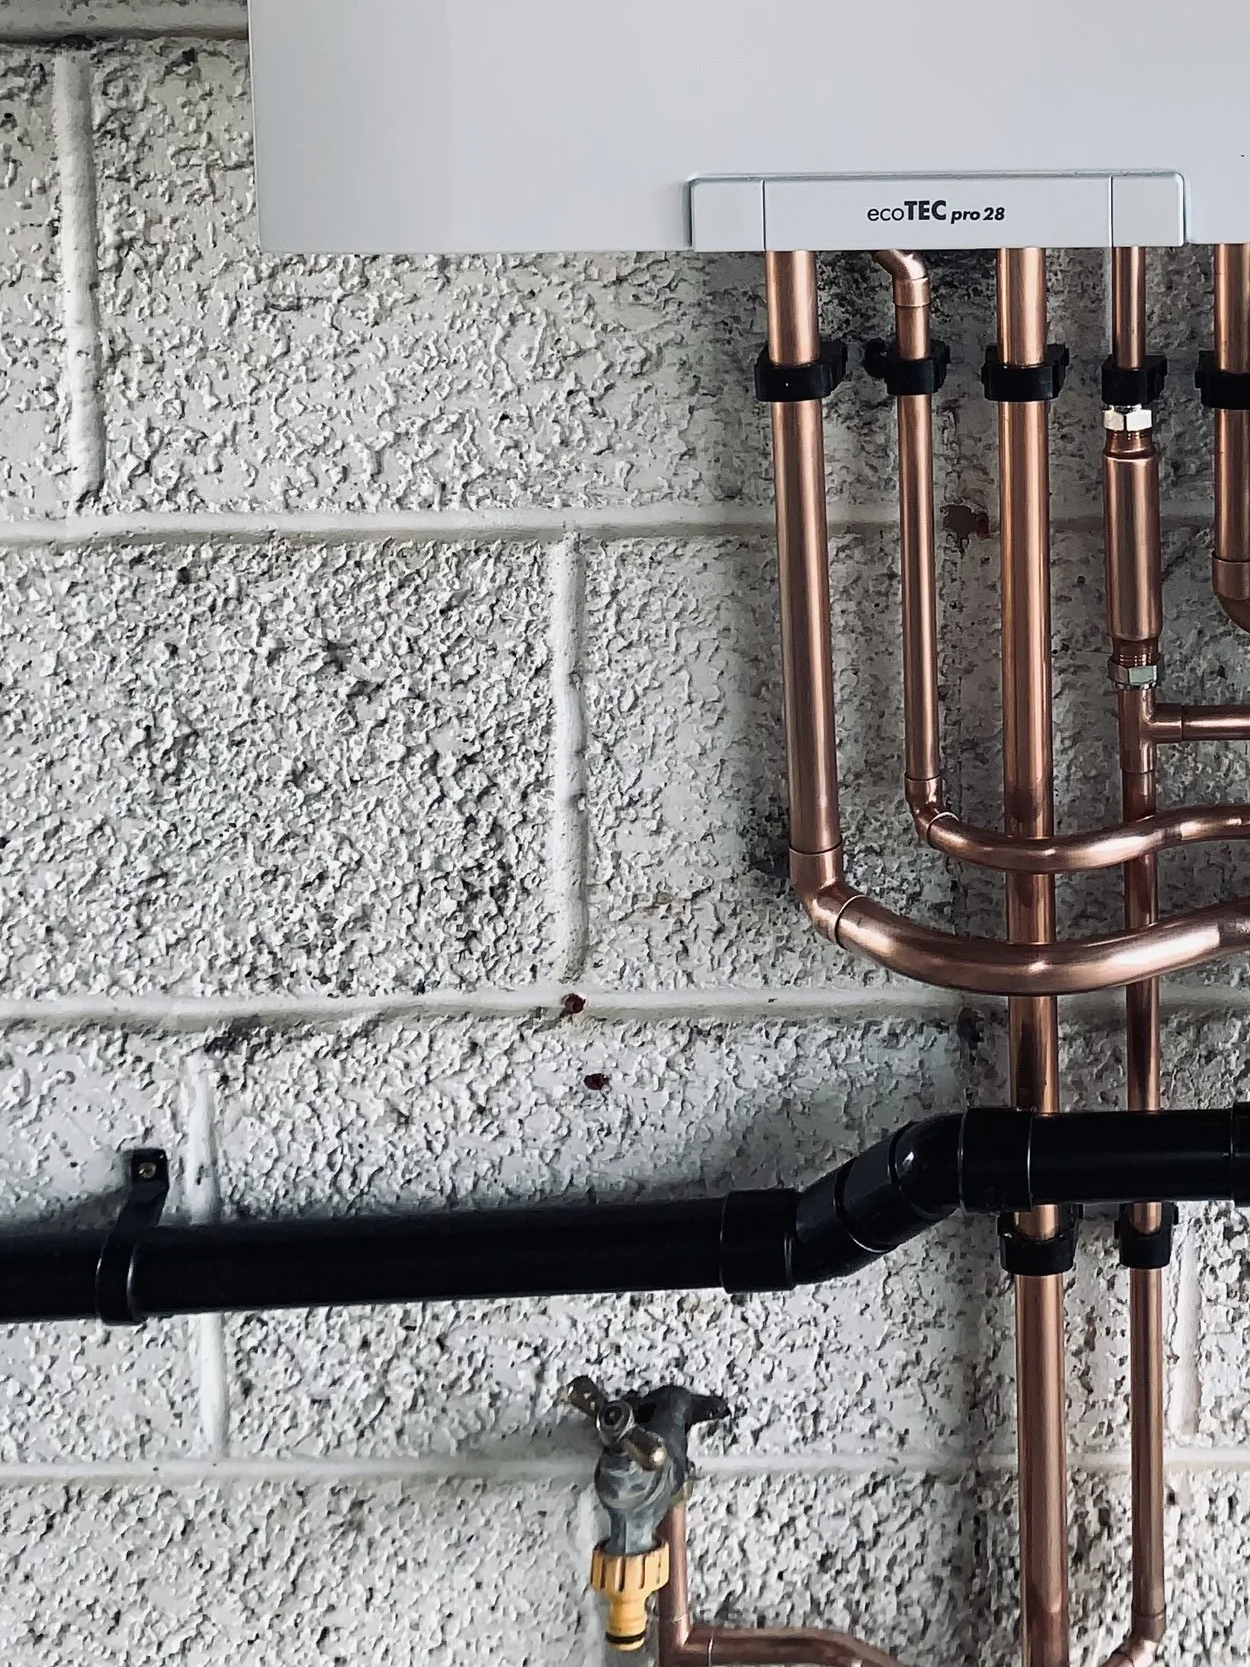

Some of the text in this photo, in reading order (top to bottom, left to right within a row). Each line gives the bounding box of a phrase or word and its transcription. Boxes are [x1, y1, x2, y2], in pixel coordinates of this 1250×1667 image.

[867, 200, 1005, 225] ecoTEC pro 28
